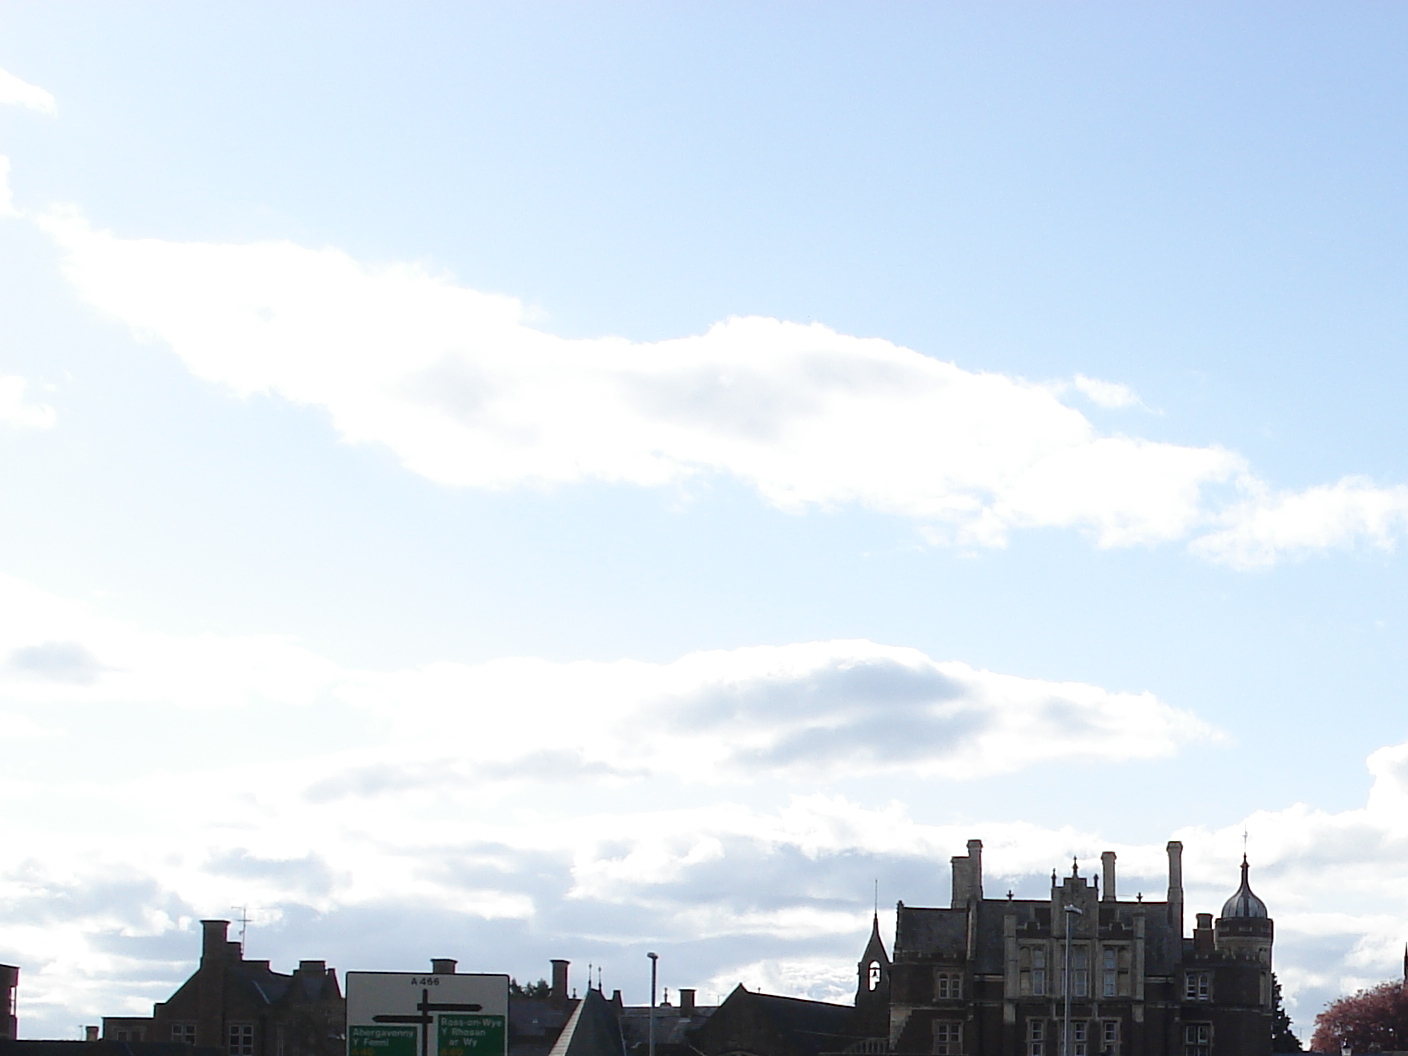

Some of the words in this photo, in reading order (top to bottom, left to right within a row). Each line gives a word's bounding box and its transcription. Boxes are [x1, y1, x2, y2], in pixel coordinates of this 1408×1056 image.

[352, 1028, 414, 1038] Abergavenny
[364, 1038, 389, 1046] Fenni
[463, 1038, 478, 1048] Wy
